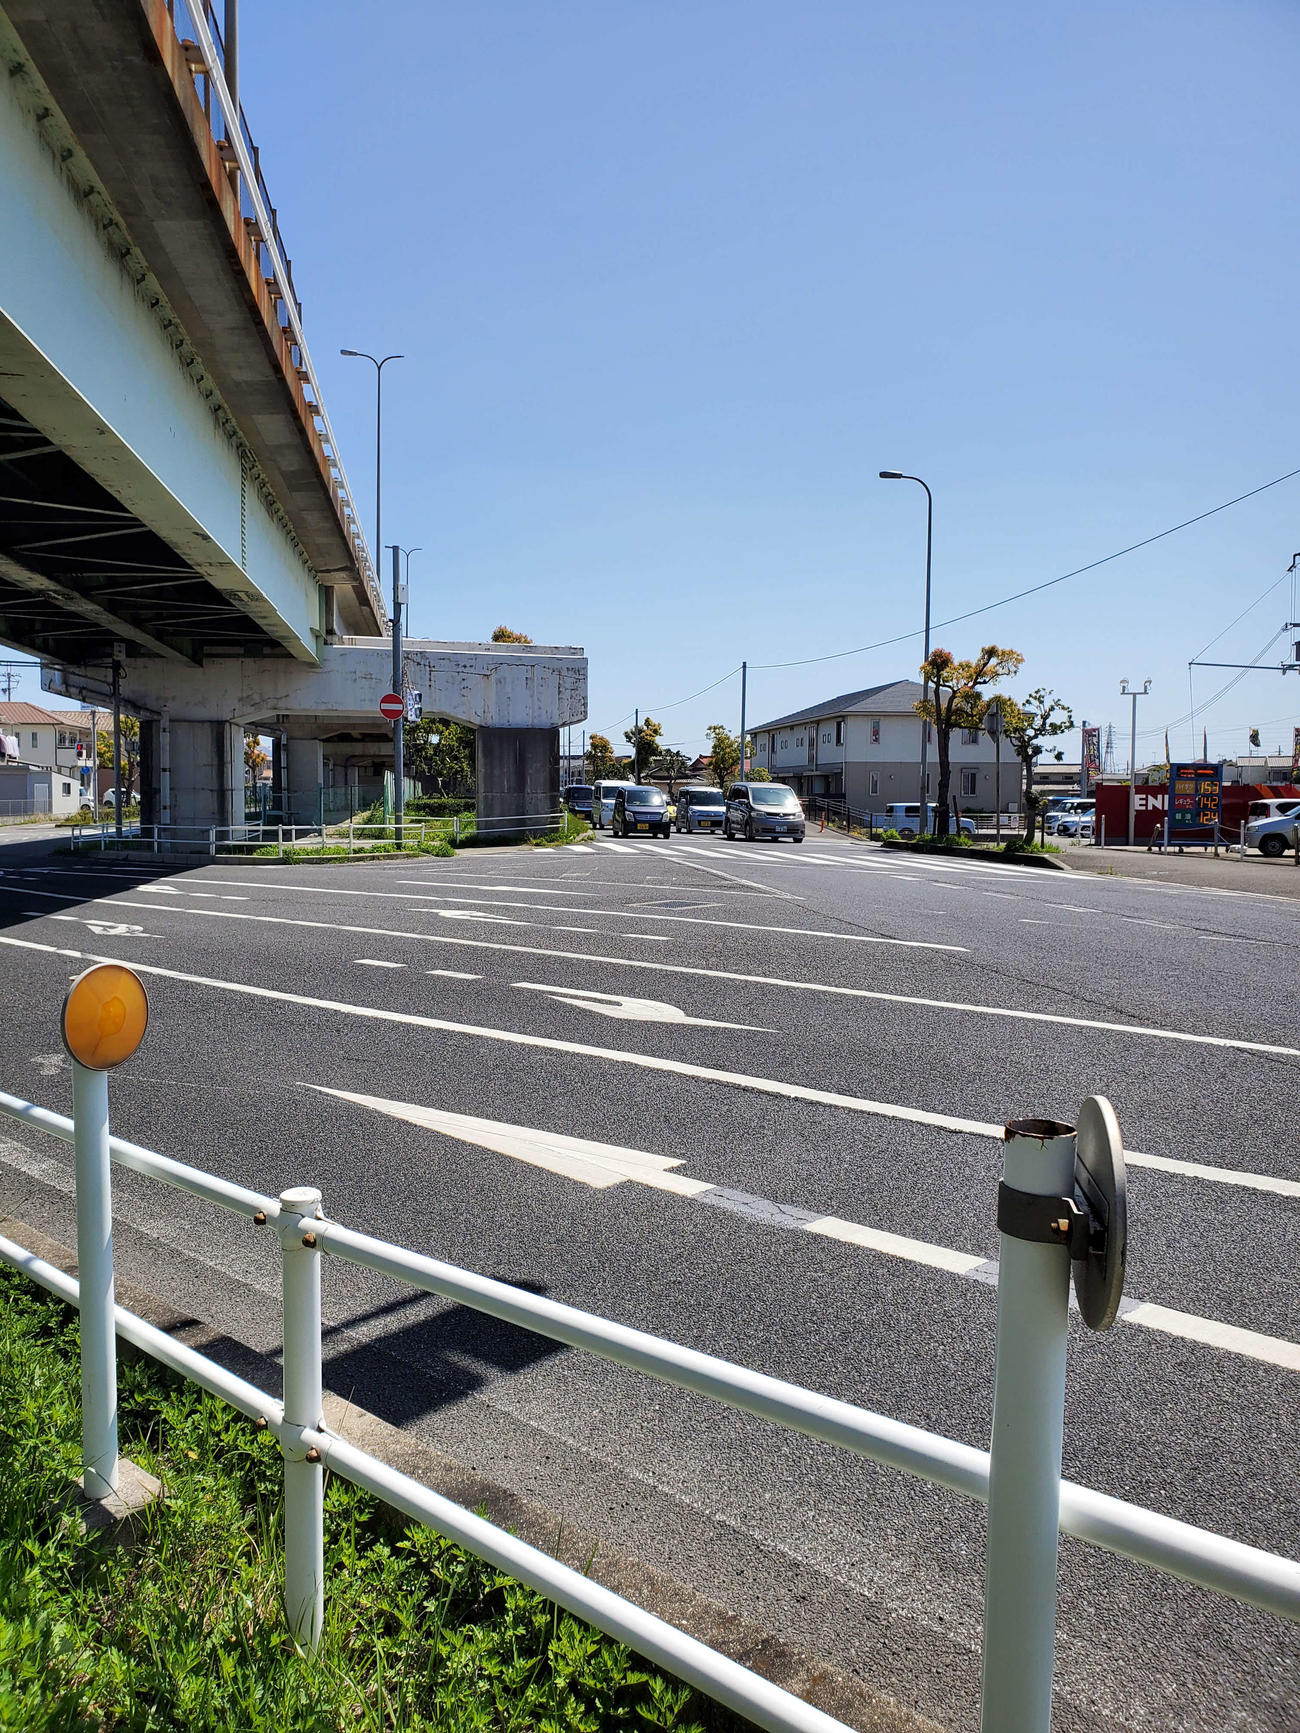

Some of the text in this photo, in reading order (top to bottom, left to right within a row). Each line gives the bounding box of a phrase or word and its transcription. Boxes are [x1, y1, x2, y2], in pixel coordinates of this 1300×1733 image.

[1200, 781, 1219, 794] 153
[1200, 796, 1219, 809] 142
[1200, 811, 1218, 824] 124
